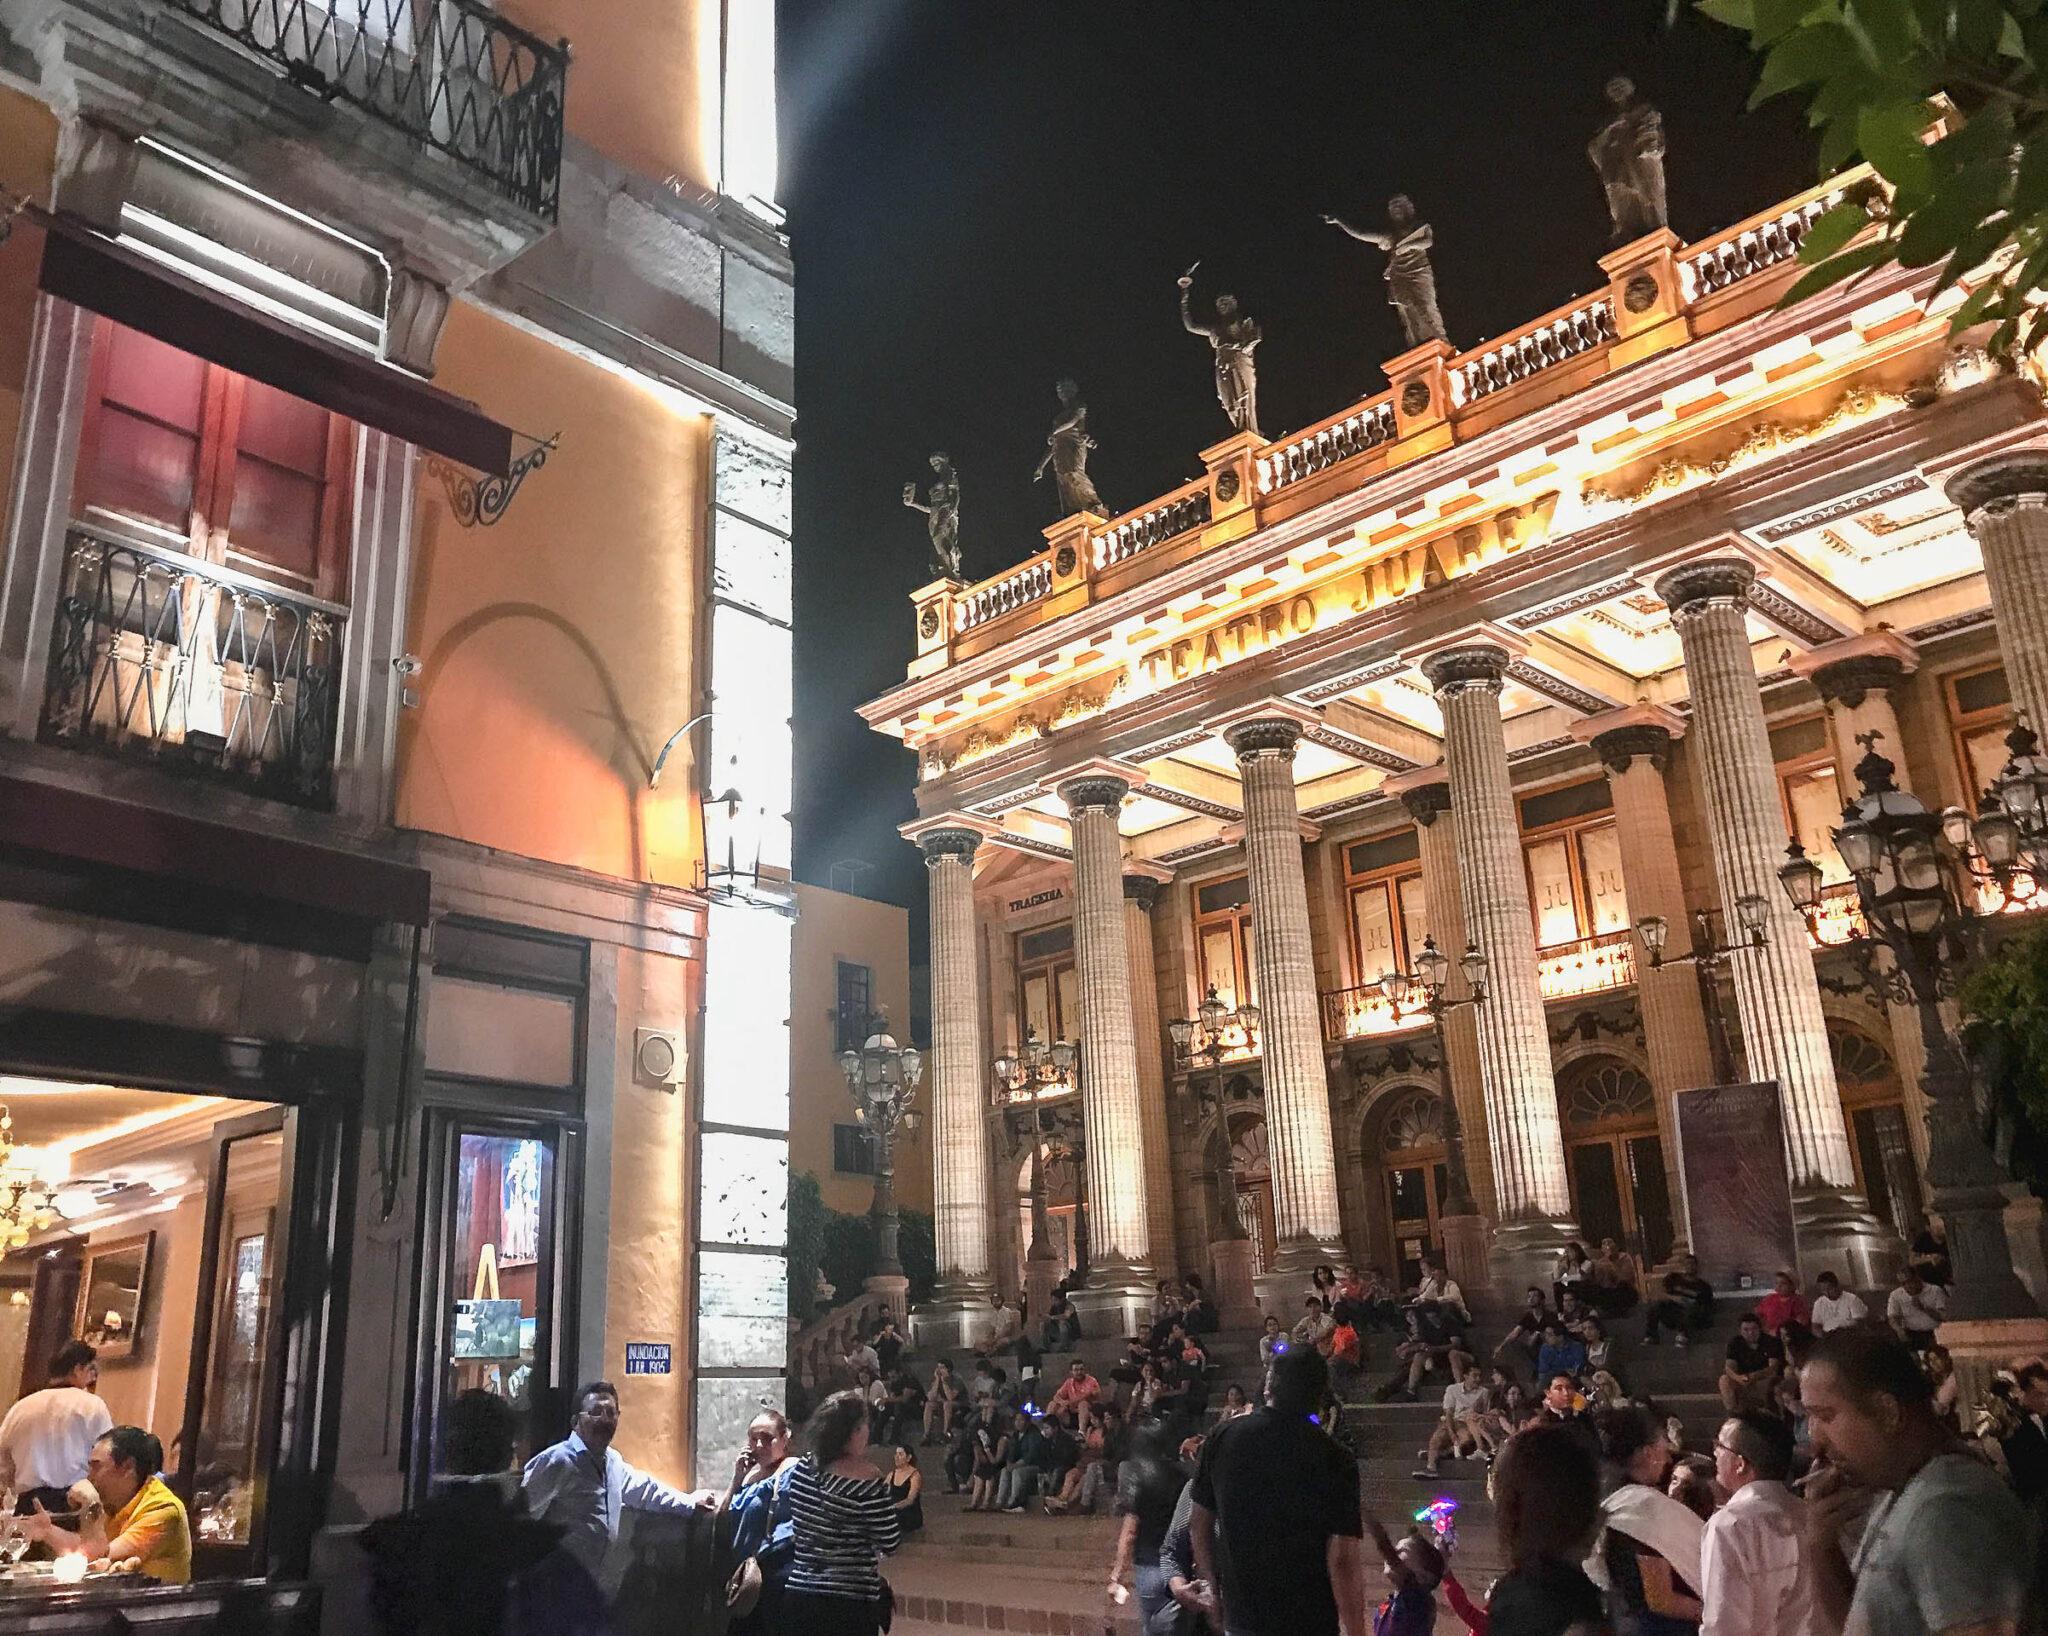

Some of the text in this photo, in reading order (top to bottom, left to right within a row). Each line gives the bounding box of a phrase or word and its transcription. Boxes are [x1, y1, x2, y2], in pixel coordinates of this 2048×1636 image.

[1138, 592, 1317, 683] TEATRO
[1008, 888, 1064, 912] TRAGEDIA
[649, 1361, 666, 1373] 1905
